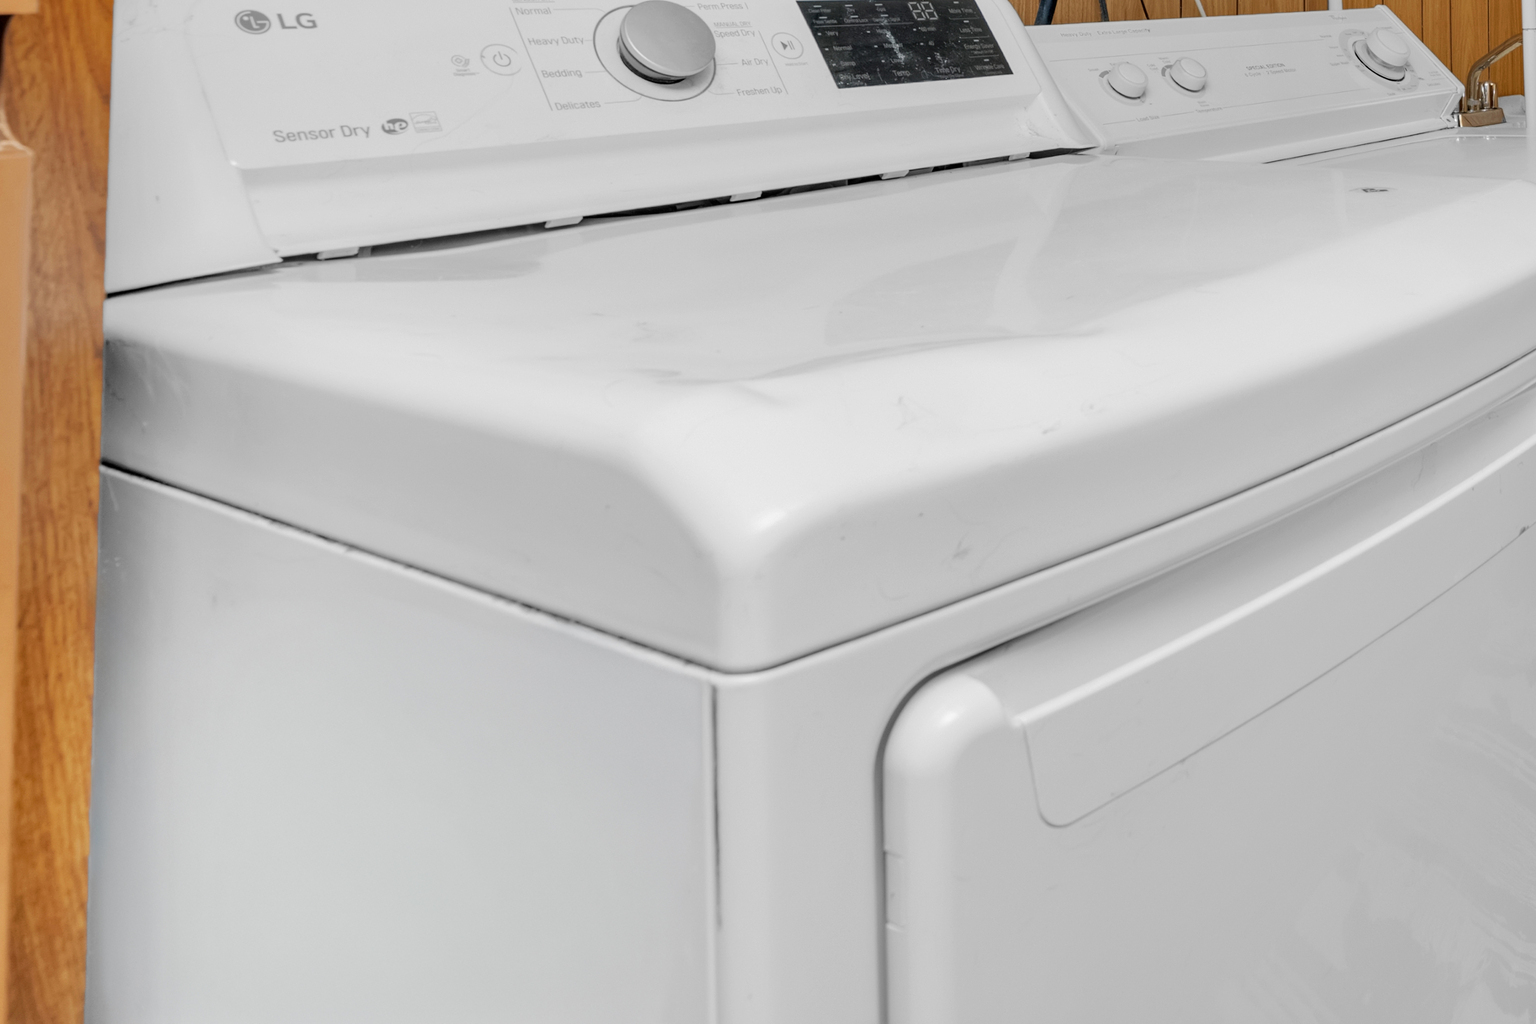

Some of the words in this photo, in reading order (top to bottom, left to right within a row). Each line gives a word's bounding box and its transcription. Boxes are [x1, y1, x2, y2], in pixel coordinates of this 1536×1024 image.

[515, 6, 552, 16] Normal
[276, 12, 318, 30] LG
[713, 29, 741, 39] Speed
[740, 28, 756, 38] Dry
[527, 37, 559, 47] Heavy
[560, 36, 585, 45] Duty
[741, 58, 753, 66] Air
[753, 57, 769, 67] Dry
[541, 69, 583, 78] Bedding
[892, 69, 912, 78] Temp
[949, 65, 961, 74] Dry
[735, 86, 770, 97] Freshen
[768, 86, 783, 95] Up
[554, 101, 601, 111] Delicates
[1195, 106, 1223, 114] Temperature
[1135, 115, 1151, 123] Load
[272, 128, 337, 143] Sensor
[339, 125, 371, 139] Dry
